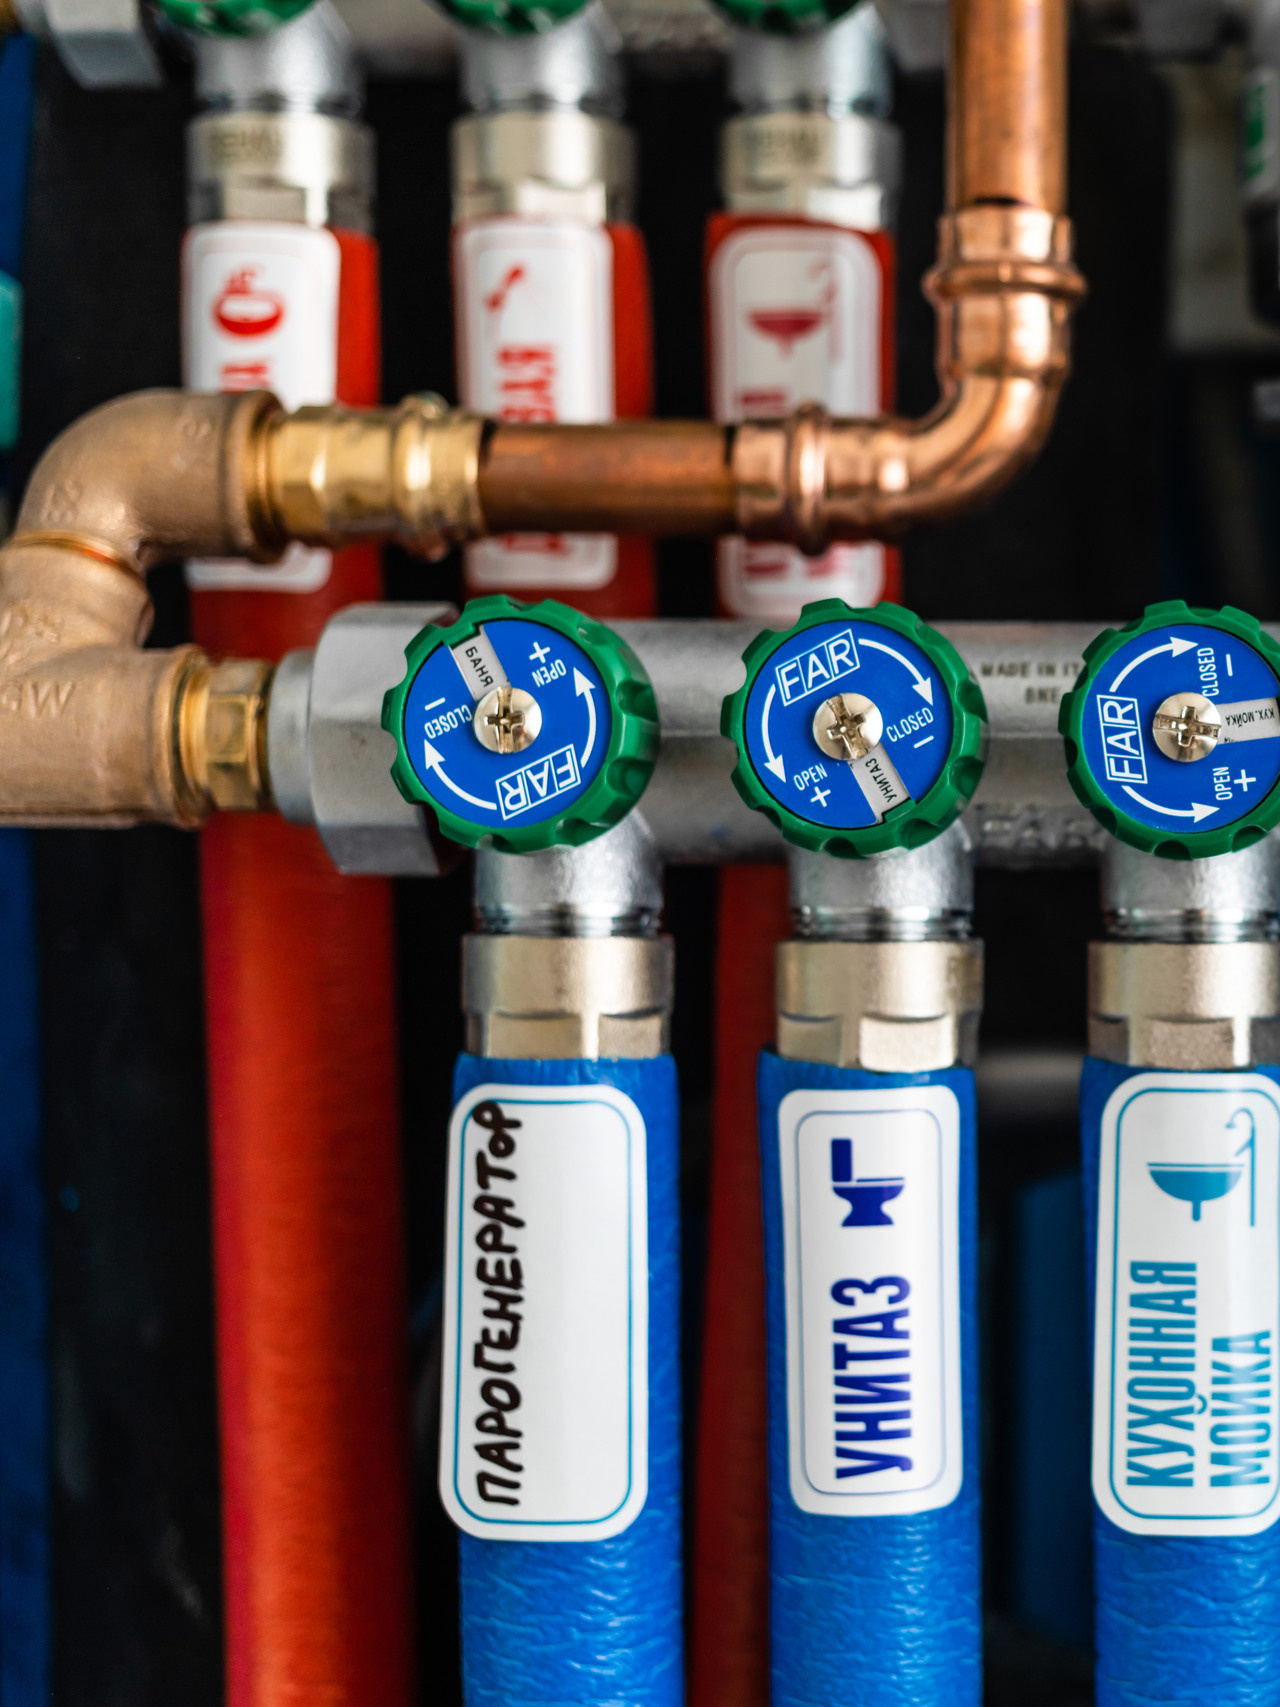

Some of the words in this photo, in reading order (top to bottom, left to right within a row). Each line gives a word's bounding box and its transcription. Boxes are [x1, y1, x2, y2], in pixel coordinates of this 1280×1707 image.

[465, 646, 494, 687] БАНЯ
[532, 659, 567, 687] OPEN
[778, 634, 857, 703] FAR
[1197, 647, 1220, 697] CLOSED
[424, 704, 473, 740] CLOSED
[886, 706, 934, 743] CLOSED
[1101, 697, 1145, 782] FAR
[499, 748, 580, 815] FAR
[793, 763, 828, 791] OPEN
[865, 757, 898, 803] УНИТАЗ
[1213, 766, 1232, 800] OPEN
[471, 1100, 526, 1506] ПАРОГЕНЕРАТОР
[830, 1275, 913, 1479] УНИТАЗ
[1126, 1260, 1197, 1487] КУХОННАЯ
[1196, 1330, 1271, 1488] МОЙКА
